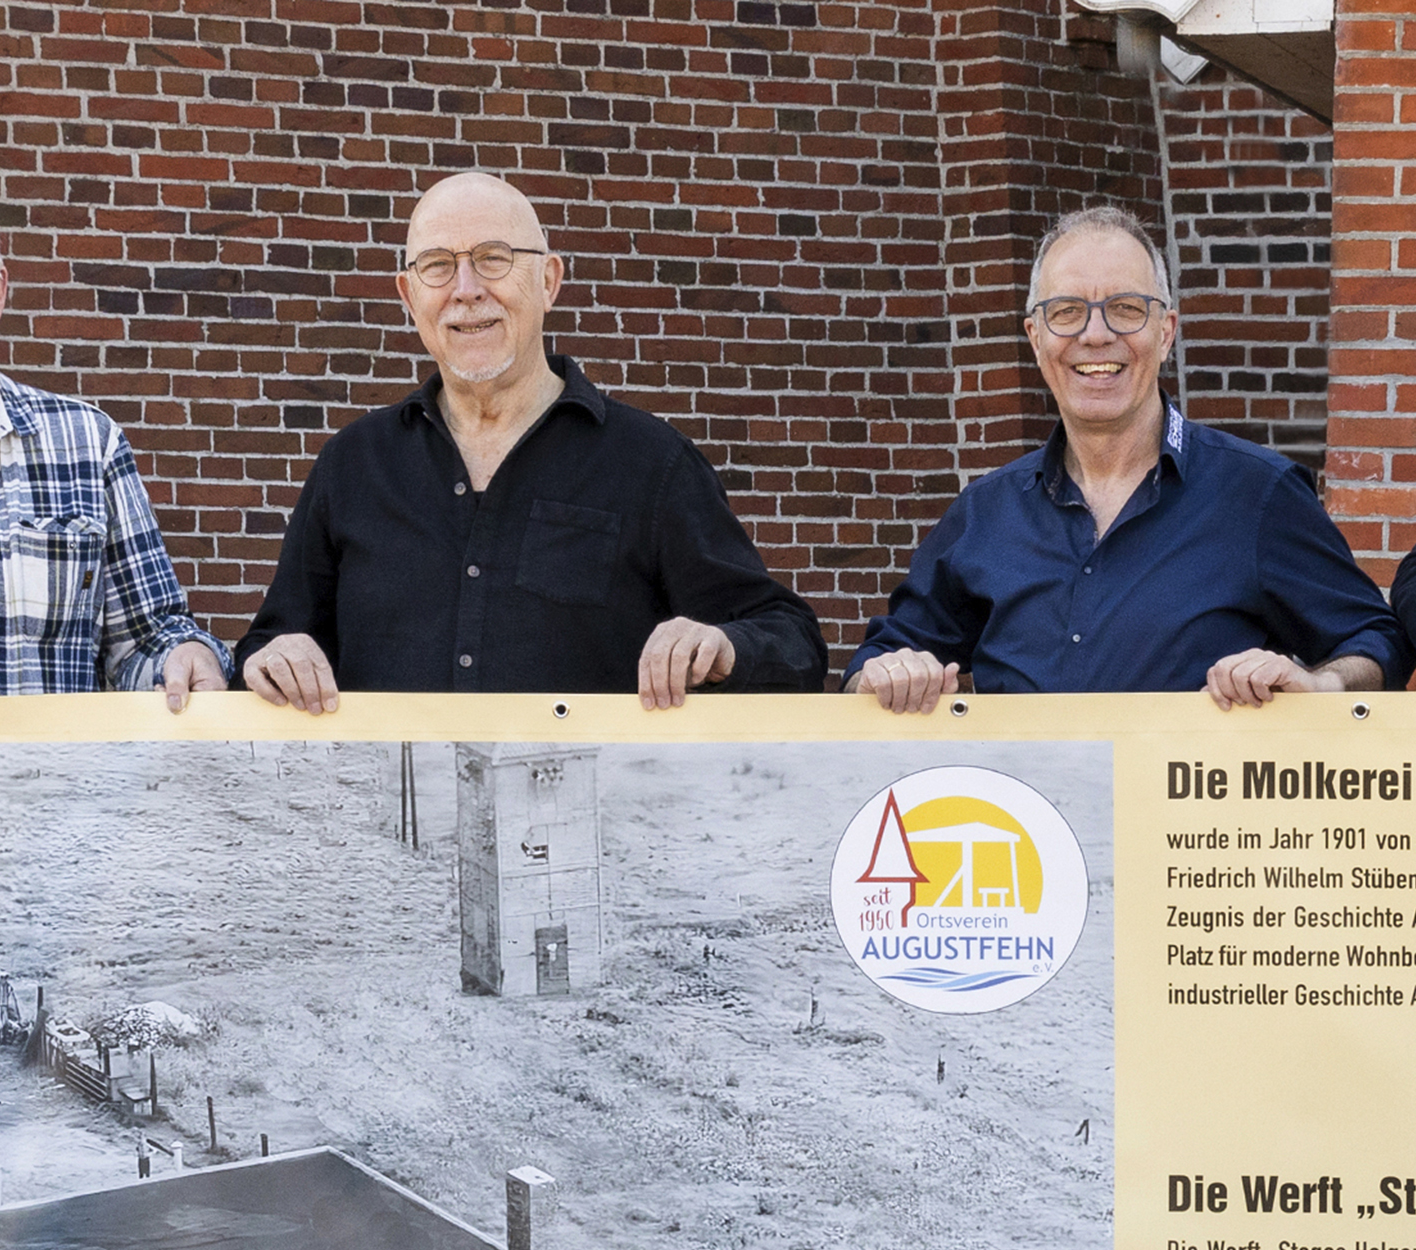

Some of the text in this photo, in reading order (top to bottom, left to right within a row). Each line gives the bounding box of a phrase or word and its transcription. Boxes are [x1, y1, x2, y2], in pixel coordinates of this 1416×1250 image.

[1167, 761, 1228, 800] Die
[1242, 761, 1412, 801] Molkerei
[1166, 827, 1229, 850] wurde
[1237, 827, 1262, 850] im
[1269, 827, 1314, 850] Jahr
[1321, 827, 1365, 850] 1901
[1375, 834, 1411, 851] von
[1167, 866, 1256, 889] Friedrich
[1263, 866, 1343, 889] Wilhelm
[863, 887, 892, 907] seit
[859, 910, 895, 932] 1950
[916, 912, 1009, 929] Ortsverein
[1166, 905, 1245, 934] Zeugnis
[1253, 905, 1287, 928] der
[1294, 905, 1404, 929] Geschichte
[861, 936, 1054, 961] AUGUSTFEHN
[1167, 944, 1214, 966] Platz
[1218, 944, 1248, 966] für
[1253, 944, 1340, 967] moderne
[1168, 982, 1289, 1006] industrieller
[1295, 983, 1404, 1006] Geschichte
[1168, 1174, 1228, 1214] Die
[1241, 1175, 1343, 1214] Werft
